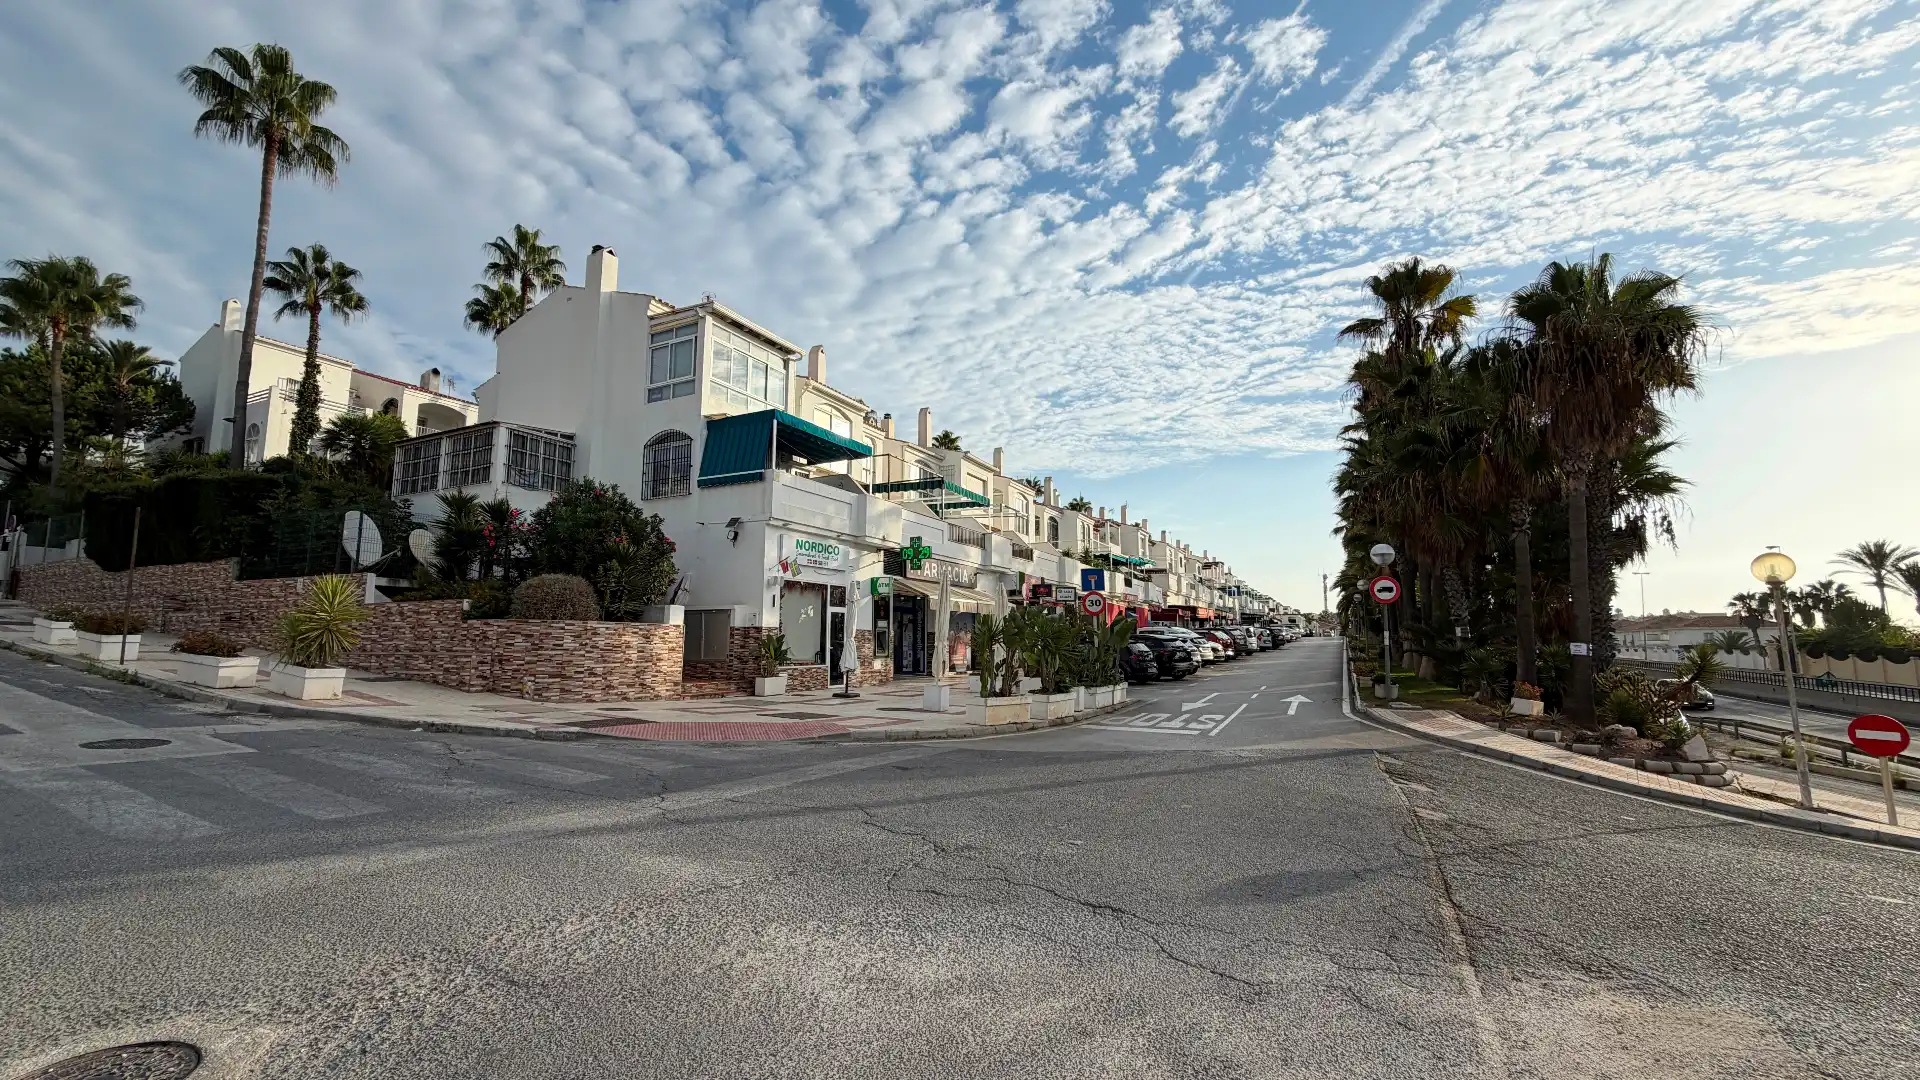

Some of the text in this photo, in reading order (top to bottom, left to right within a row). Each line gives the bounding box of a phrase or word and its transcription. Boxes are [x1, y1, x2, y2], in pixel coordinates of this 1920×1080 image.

[795, 539, 840, 556] NORDICO
[902, 547, 930, 559] 09 29
[1087, 599, 1102, 607] 30
[1100, 712, 1226, 729] STOP
